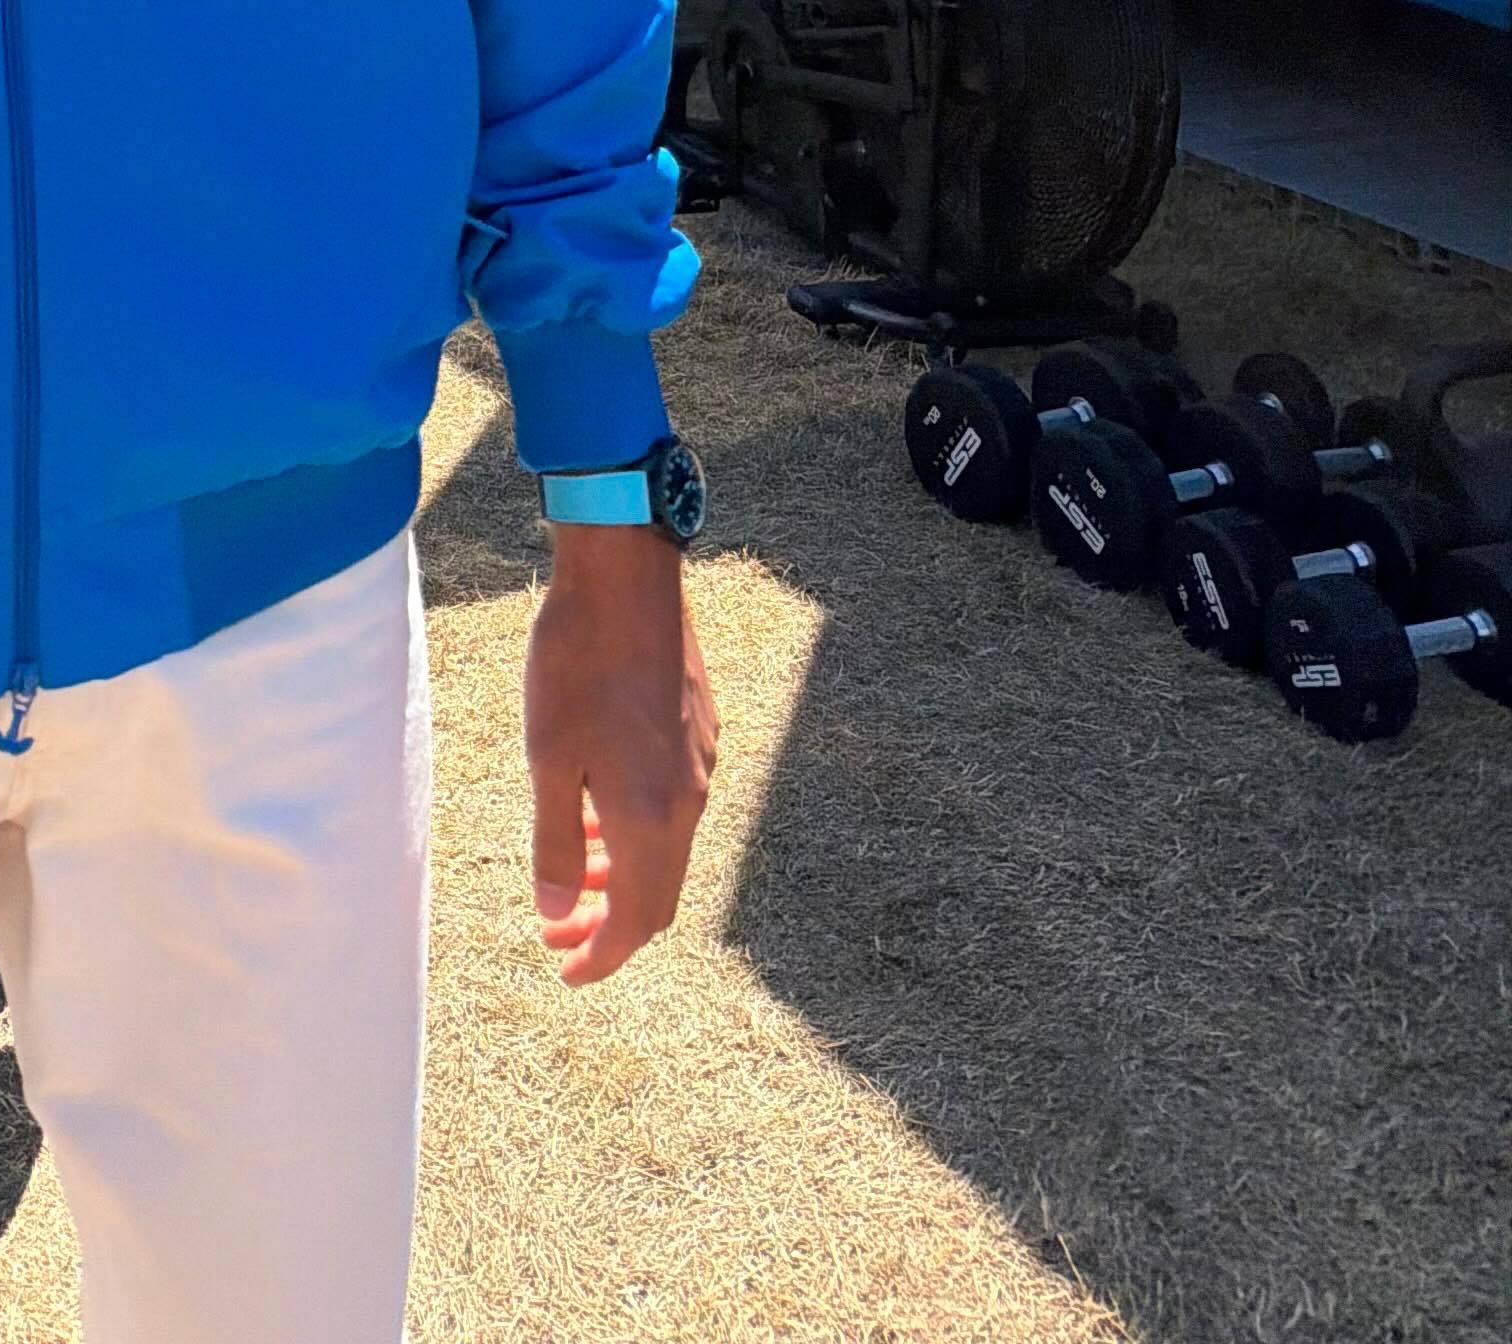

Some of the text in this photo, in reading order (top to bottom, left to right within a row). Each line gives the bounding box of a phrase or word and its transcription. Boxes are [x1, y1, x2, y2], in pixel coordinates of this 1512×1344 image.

[943, 426, 983, 488] ESP
[1048, 484, 1106, 555] ESP
[1192, 551, 1231, 631] ESP
[1291, 663, 1343, 689] ESP
